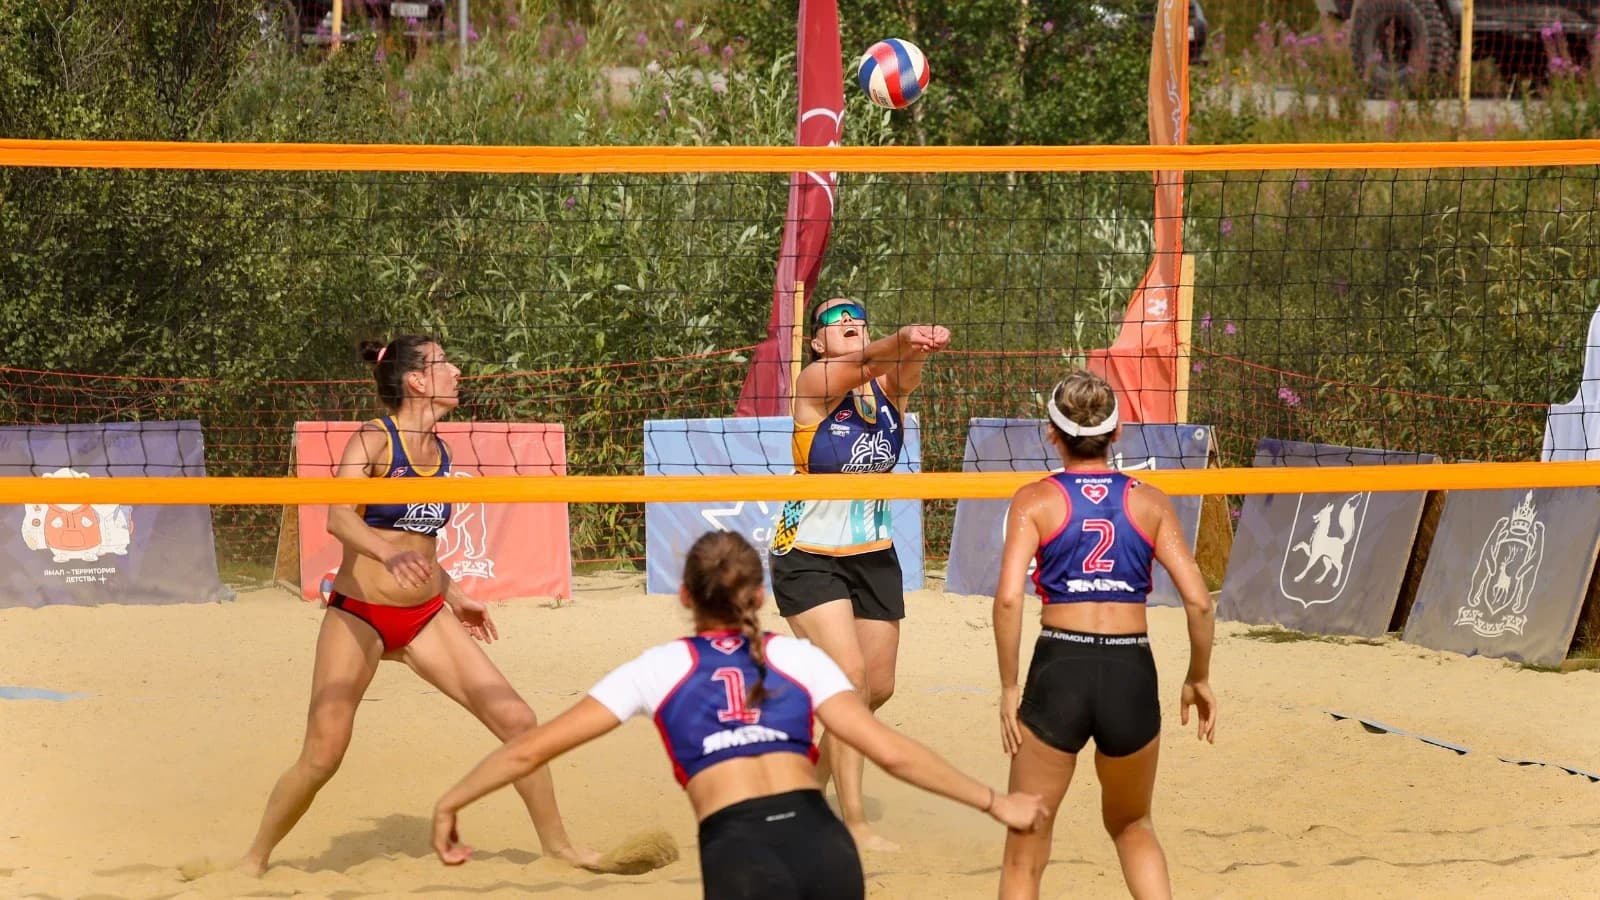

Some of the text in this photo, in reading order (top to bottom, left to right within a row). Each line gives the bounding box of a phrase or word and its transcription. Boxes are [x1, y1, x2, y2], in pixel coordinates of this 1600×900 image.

[881, 405, 898, 432] 1
[1082, 519, 1115, 573] 2
[44, 568, 65, 576] ЯМАЛ
[71, 567, 116, 576] ТЕРРИТОРИЯ
[66, 575, 97, 583] ДЕТСТВА
[1053, 632, 1095, 644] ARMOUR
[1105, 637, 1137, 645] UNDER
[711, 666, 761, 723] 1
